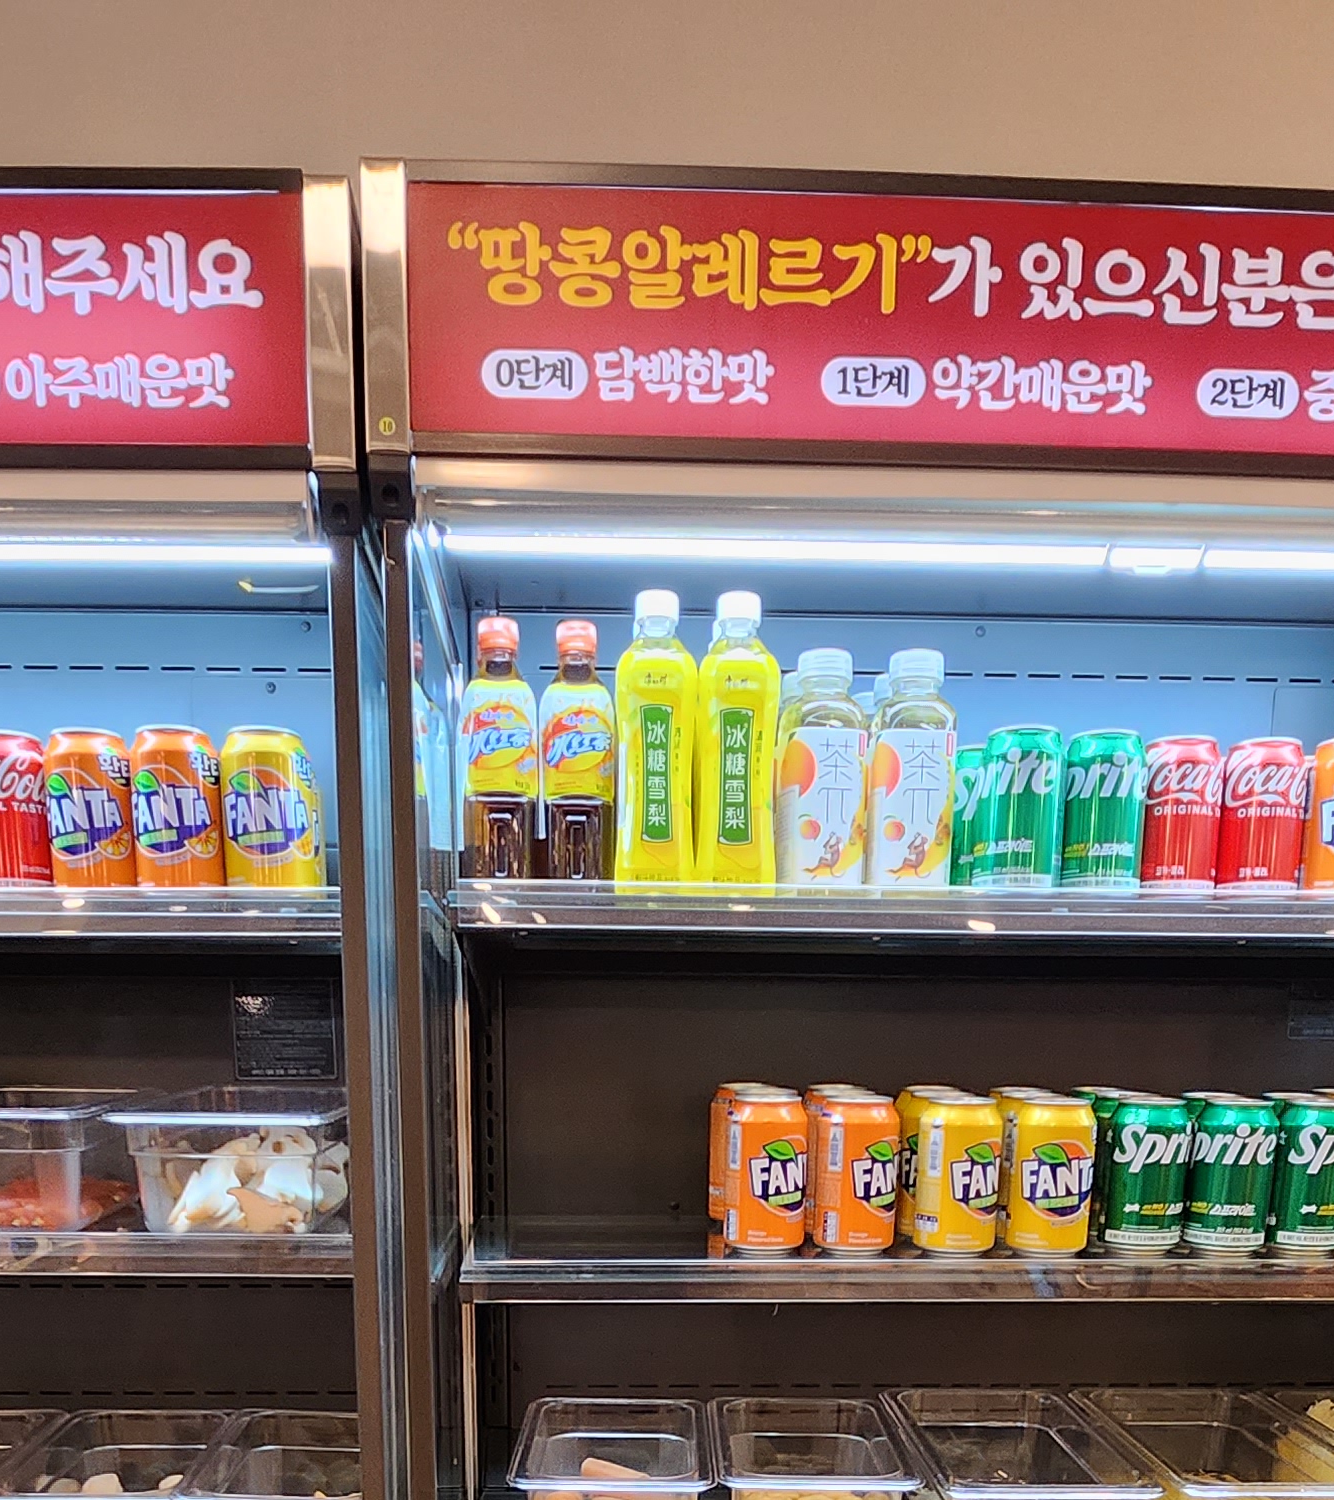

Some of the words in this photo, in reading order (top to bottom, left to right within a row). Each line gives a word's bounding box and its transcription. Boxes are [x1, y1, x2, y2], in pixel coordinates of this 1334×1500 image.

[6, 352, 233, 410] 아주매운맛
[495, 358, 576, 391] 0단계
[596, 347, 774, 405] 담백한맛
[836, 364, 915, 400] 1단계
[933, 357, 1151, 416] 약간매운맛
[1210, 376, 1286, 411] 2단계
[647, 720, 667, 826] 冰糖雪梨
[724, 724, 747, 830] 冰糖雪梨
[224, 786, 309, 838] FANTA
[1154, 805, 1214, 816] ORIGINAL
[1237, 807, 1298, 818] ORIGINAL
